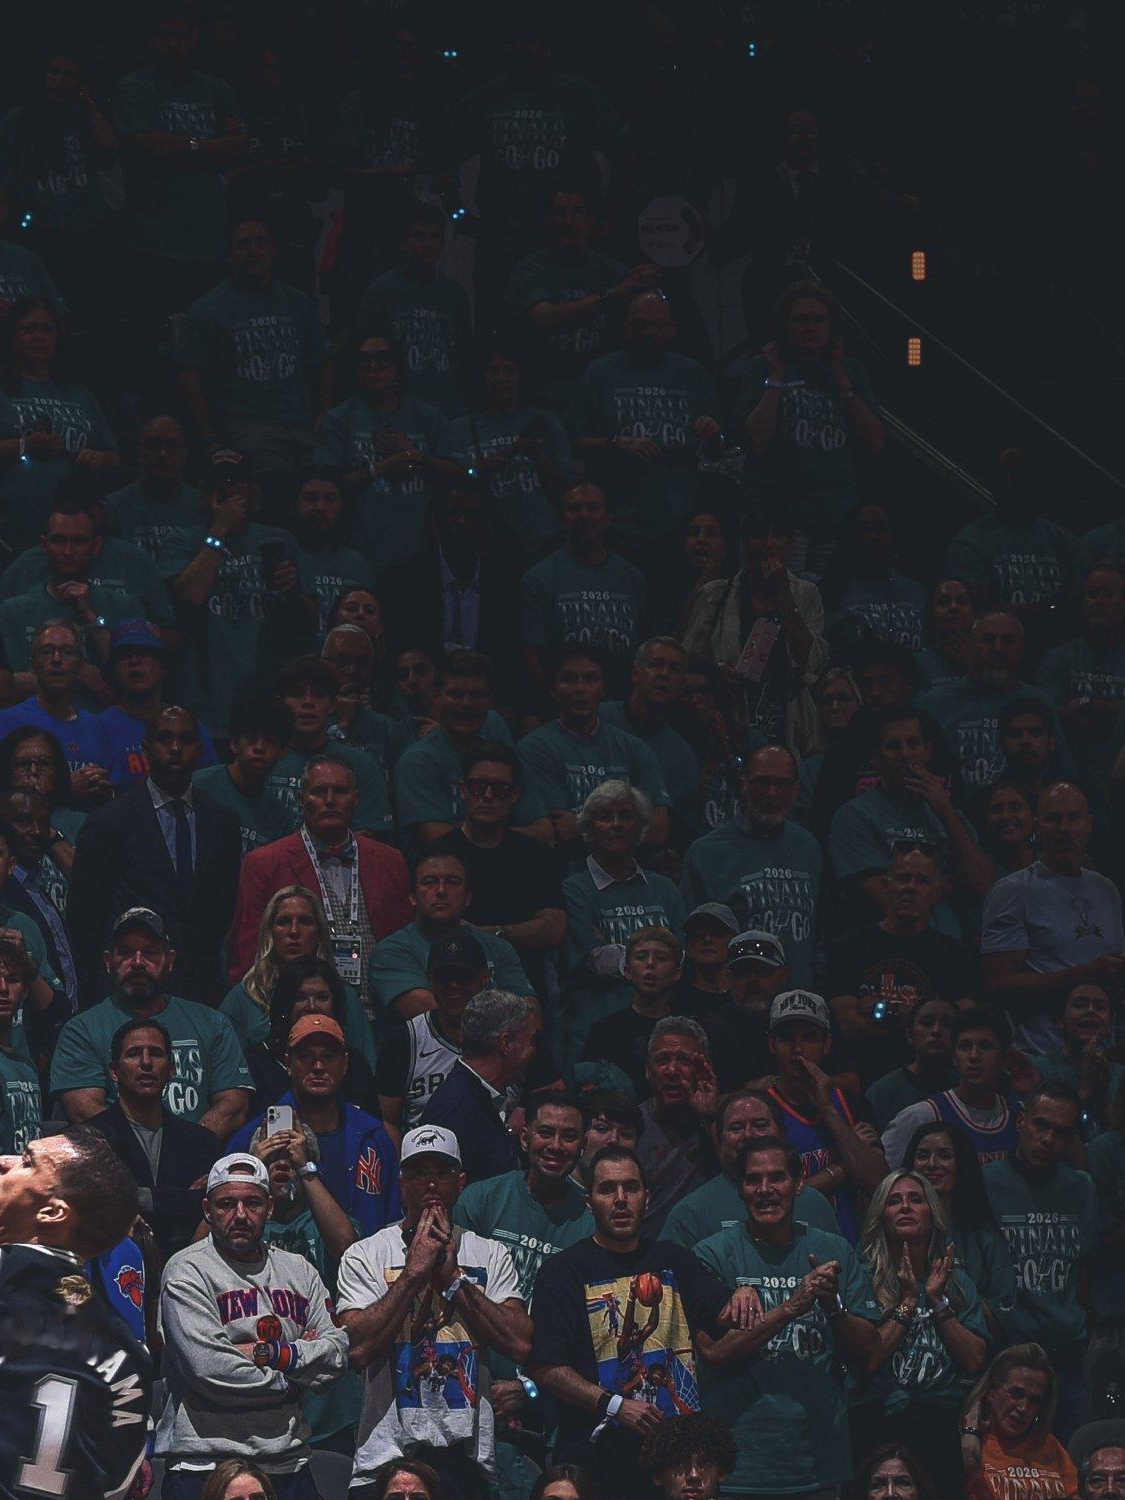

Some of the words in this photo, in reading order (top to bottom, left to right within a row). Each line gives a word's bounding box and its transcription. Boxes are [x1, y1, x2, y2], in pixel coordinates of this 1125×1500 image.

[637, 386, 667, 396] 2026
[581, 590, 611, 601] 2026
[764, 867, 793, 879] 2026
[615, 904, 645, 916] 2026
[169, 1082, 199, 1115] GO
[1027, 1212, 1059, 1224] 2026
[519, 1233, 552, 1255] 2026
[762, 1275, 797, 1289] 2026
